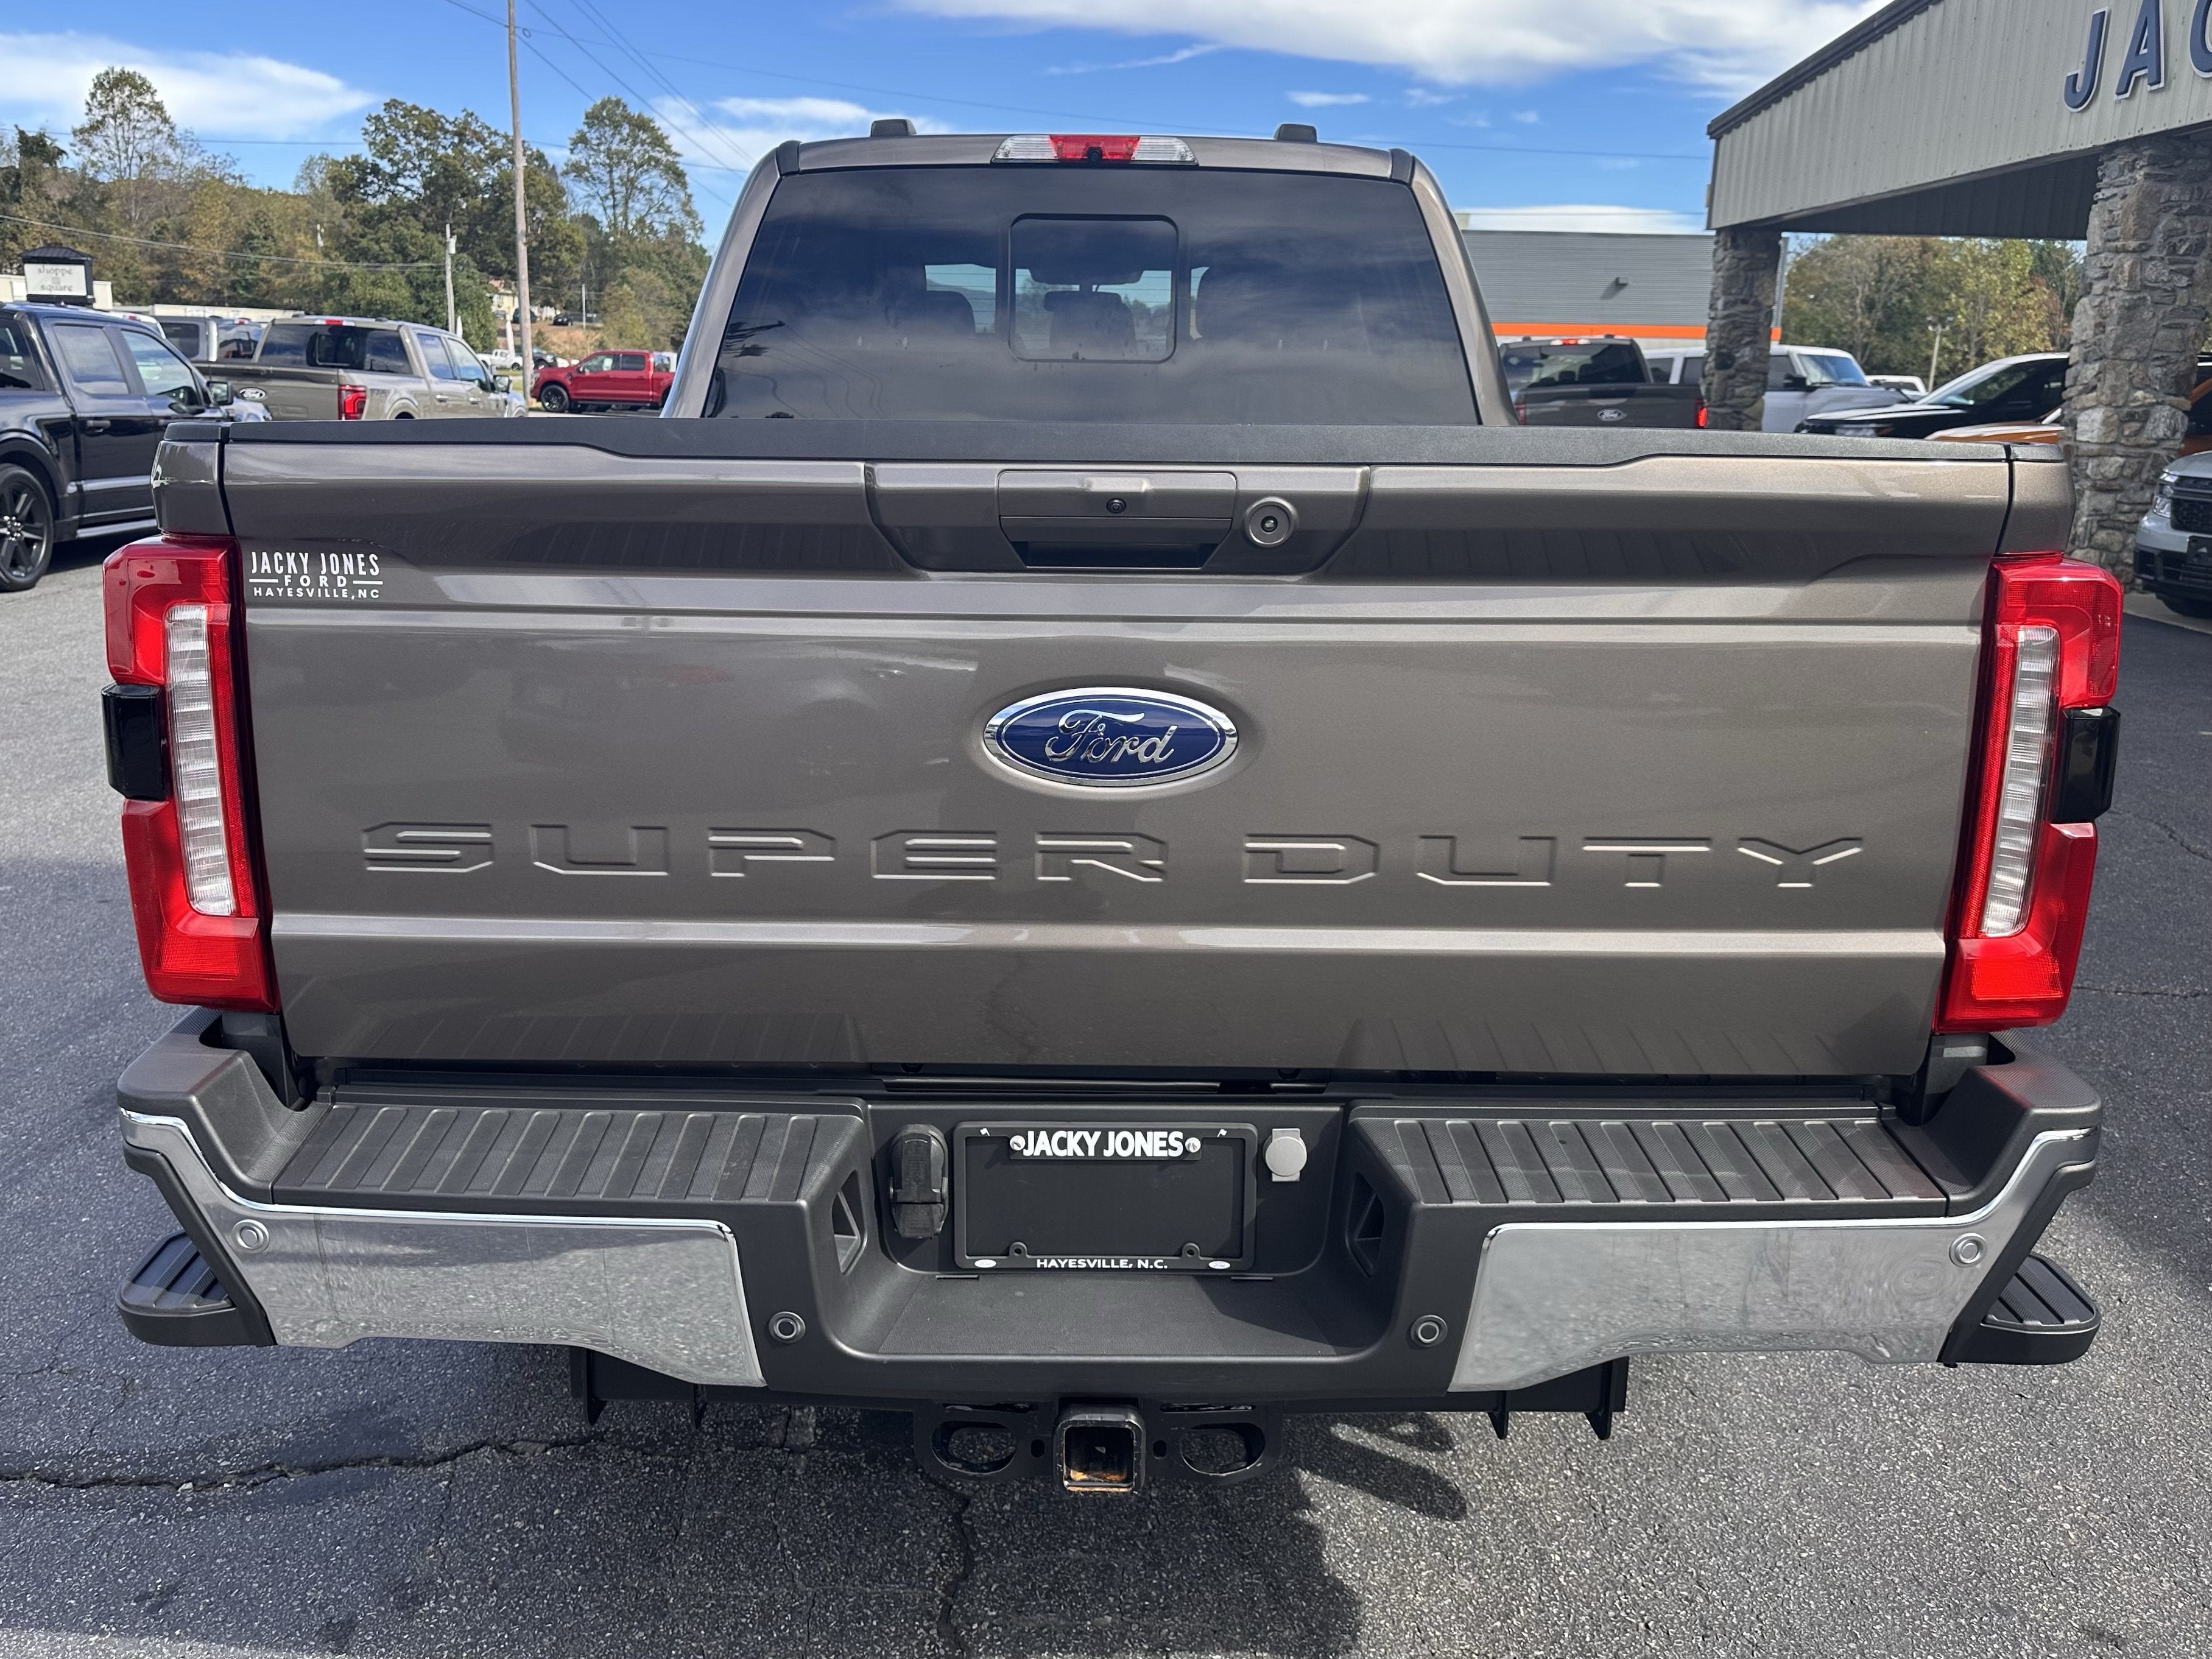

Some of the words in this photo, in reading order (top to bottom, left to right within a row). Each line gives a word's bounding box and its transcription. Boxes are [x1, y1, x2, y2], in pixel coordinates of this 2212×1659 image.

[252, 551, 309, 574] JACKY
[320, 553, 379, 576] JONES
[284, 574, 347, 587] FORD
[1044, 709, 1175, 764] Ford
[363, 821, 1168, 882] SUPER
[1243, 834, 1864, 888] DUTY
[1023, 1130, 1101, 1157] JACKY
[1103, 1131, 1183, 1157] JONES
[1036, 1258, 1133, 1269] HAYESVILLE,
[1136, 1259, 1168, 1269] N.C.
